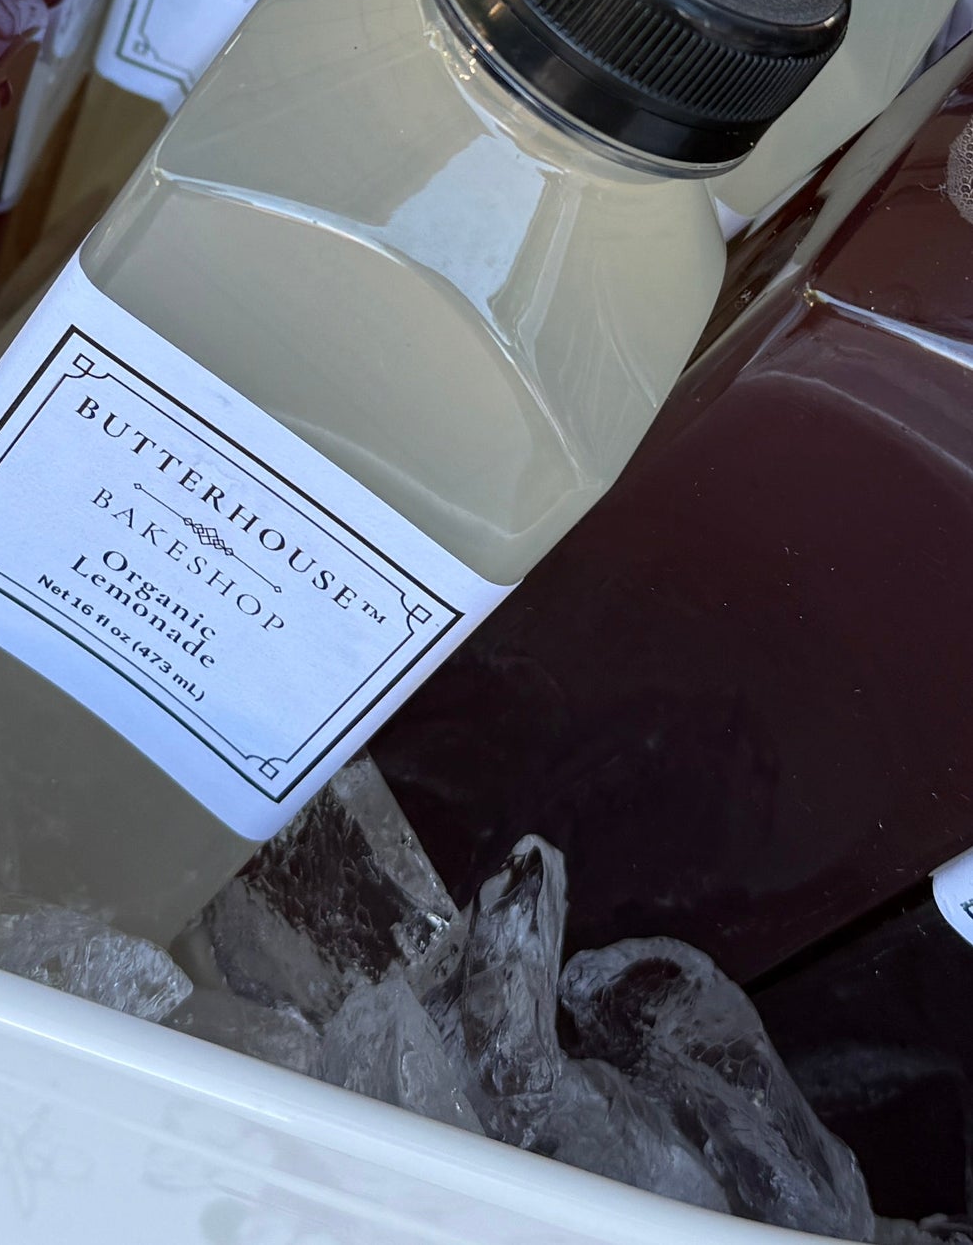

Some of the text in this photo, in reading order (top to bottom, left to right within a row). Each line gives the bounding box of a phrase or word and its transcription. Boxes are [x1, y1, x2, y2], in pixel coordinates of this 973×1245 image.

[69, 554, 216, 669] Lemonade
[90, 487, 286, 635] BAKESHOP
[101, 548, 216, 641] Organic
[37, 574, 205, 702] Net 16 fl oz (473 mL)
